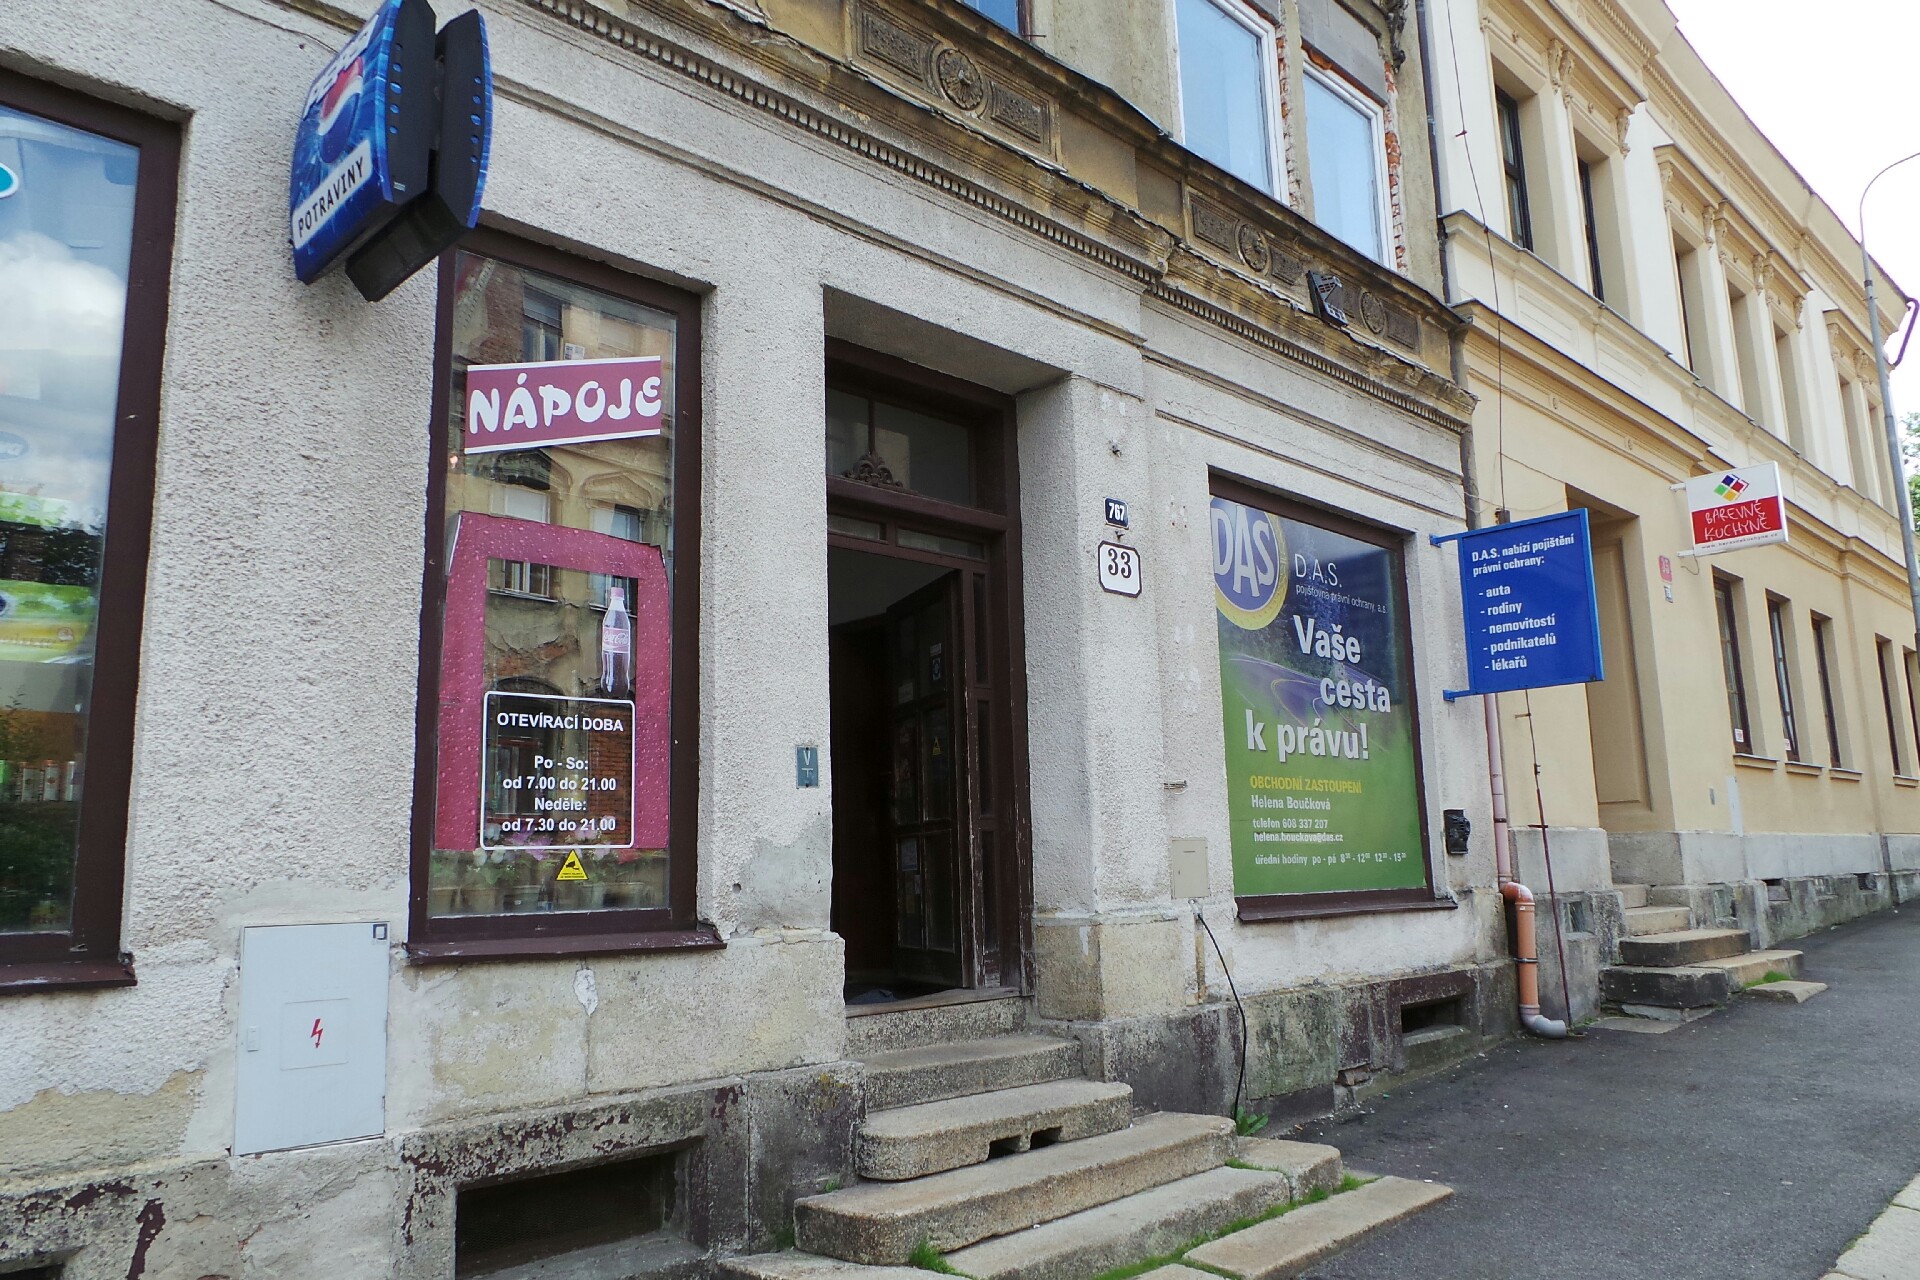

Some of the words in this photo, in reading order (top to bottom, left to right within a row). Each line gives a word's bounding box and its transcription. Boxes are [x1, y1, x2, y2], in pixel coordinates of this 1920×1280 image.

[297, 155, 365, 239] POTRAVINY
[469, 372, 661, 434] NÁPOJE
[1108, 502, 1125, 522] 767
[1705, 499, 1765, 524] BAREVNÉ
[1704, 513, 1771, 541] KUCHYNĚ
[1210, 504, 1275, 597] DAS
[1471, 548, 1500, 562] D.A.S.
[1502, 542, 1531, 557] nabízí
[1532, 533, 1575, 553] pojištění
[1107, 547, 1132, 579] 33
[1294, 553, 1343, 588] D.A.S.
[1473, 562, 1501, 577] právní
[1503, 555, 1545, 570] ochrany:
[1486, 585, 1511, 597] auta
[1487, 602, 1522, 615] rodiny
[1489, 613, 1556, 634] nemovitostí
[1293, 614, 1361, 664] Vaše
[1490, 633, 1556, 655] podnikatelů
[1492, 655, 1527, 671] lékařů
[1320, 677, 1391, 713] cesta
[496, 712, 579, 730] OTEVÍRACÍ
[582, 717, 624, 732] DOBA
[1245, 709, 1267, 751] k
[1277, 718, 1369, 763] právu!
[534, 755, 554, 769] Po
[566, 756, 589, 770] So:
[502, 776, 522, 790] od
[526, 776, 556, 790] 7.00
[559, 777, 577, 790] do
[580, 777, 617, 791] 21.00
[1250, 775, 1303, 790] OBCHODNÍ
[1305, 778, 1362, 794] ZASTOUPENÍ
[534, 797, 587, 811] Neděle:
[1250, 794, 1284, 809] Helena
[1286, 796, 1331, 810] Boučková
[501, 818, 521, 832] od
[525, 818, 555, 831] 7.30
[558, 818, 577, 831] do
[580, 818, 616, 831] 21.00
[1252, 818, 1280, 829] telefon
[1282, 818, 1297, 829] 608
[1299, 819, 1312, 829] 337
[1314, 819, 1328, 829] 207
[1254, 832, 1344, 843] helena.bouckova@das.cz
[1255, 854, 1280, 865] úřední
[1282, 853, 1308, 866] hodiny
[1312, 855, 1322, 866] po
[1328, 855, 1337, 866] pá
